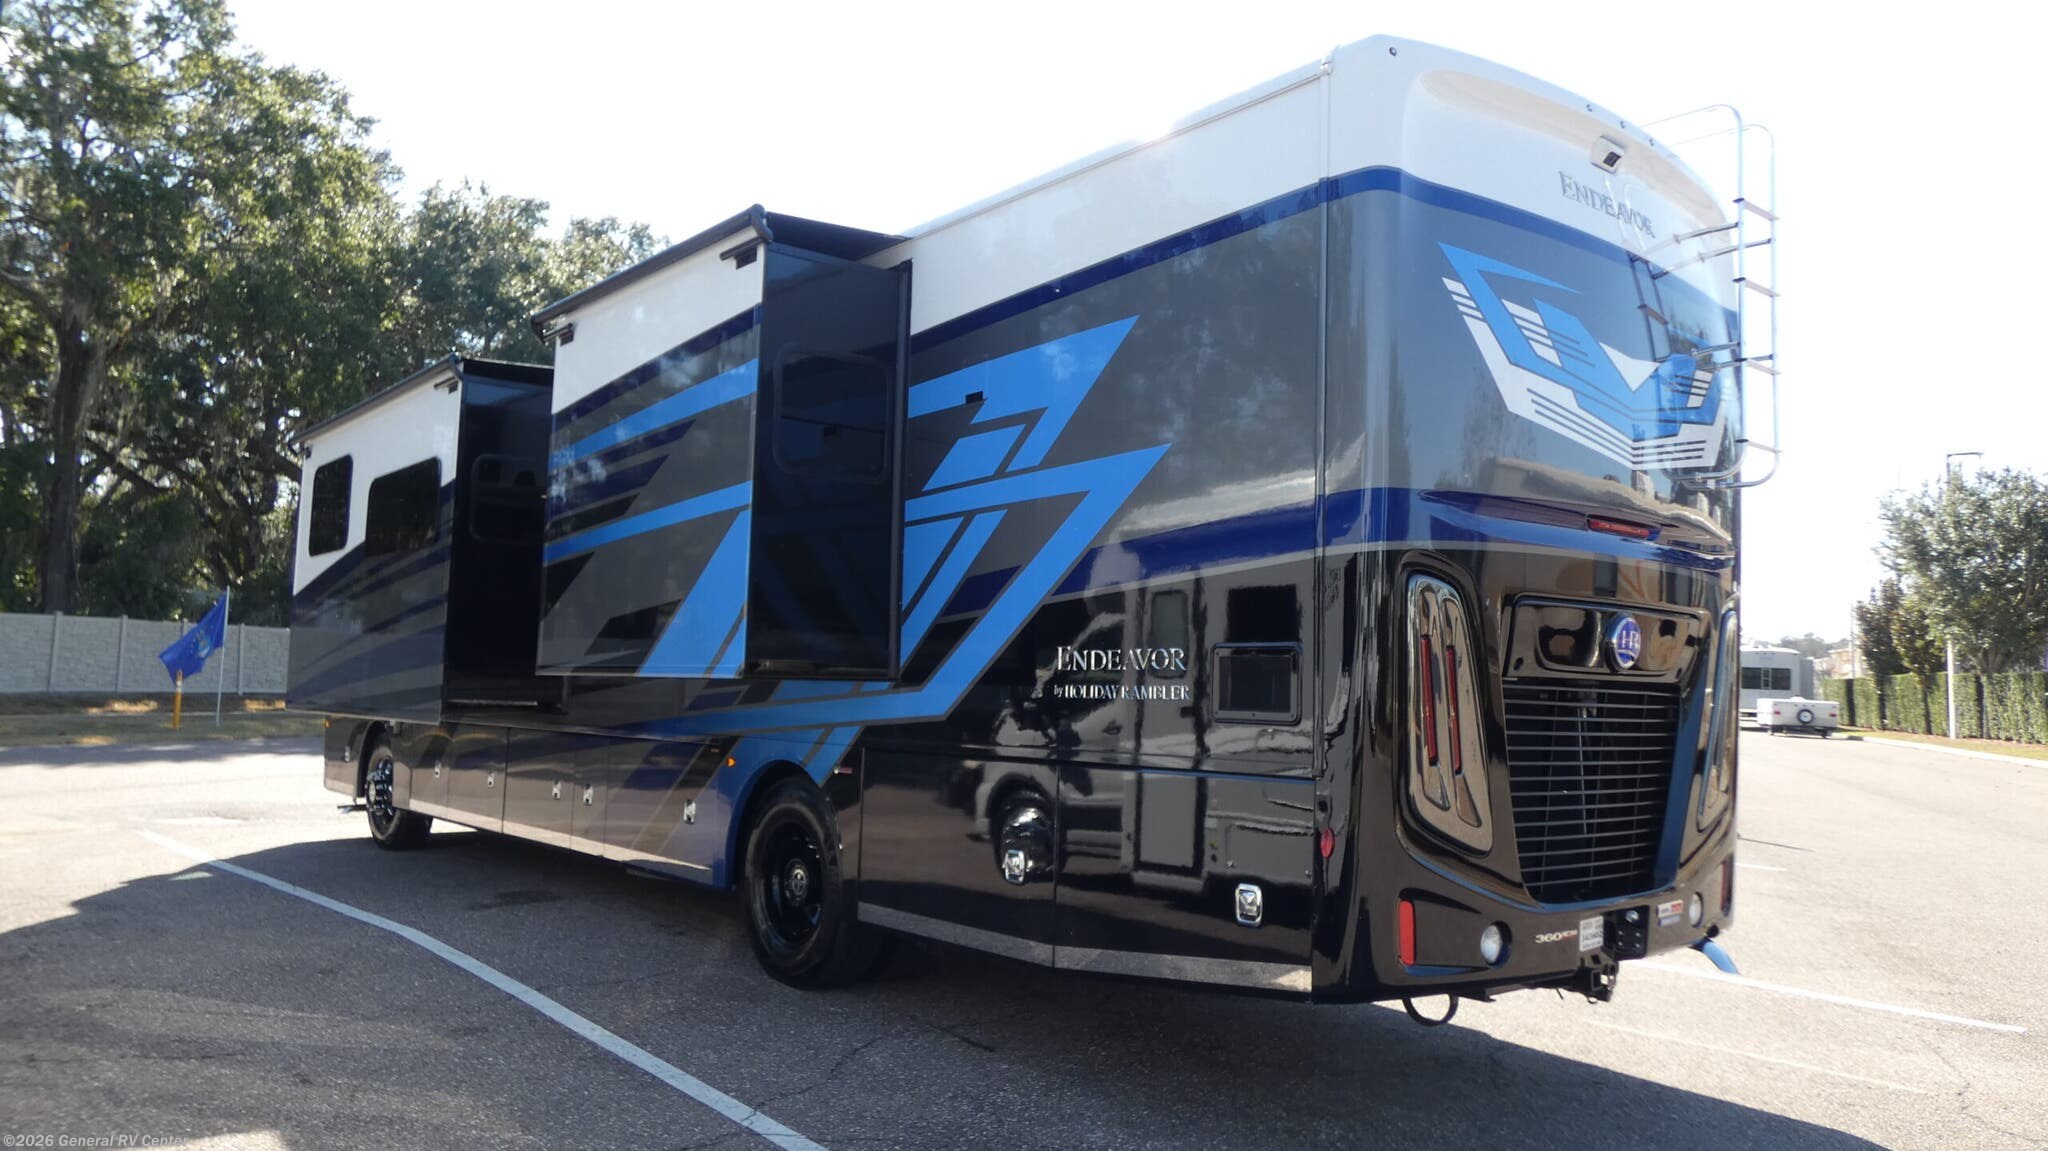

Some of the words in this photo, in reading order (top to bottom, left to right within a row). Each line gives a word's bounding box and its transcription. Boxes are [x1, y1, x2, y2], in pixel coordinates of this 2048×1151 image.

[1558, 170, 1656, 239] ENDEAVOR
[1621, 630, 1640, 649] HR
[1057, 646, 1187, 671] ENDEAVOR
[1054, 685, 1064, 697] by
[1065, 685, 1119, 699] HOLIDAY
[1121, 685, 1190, 700] RAMBLER
